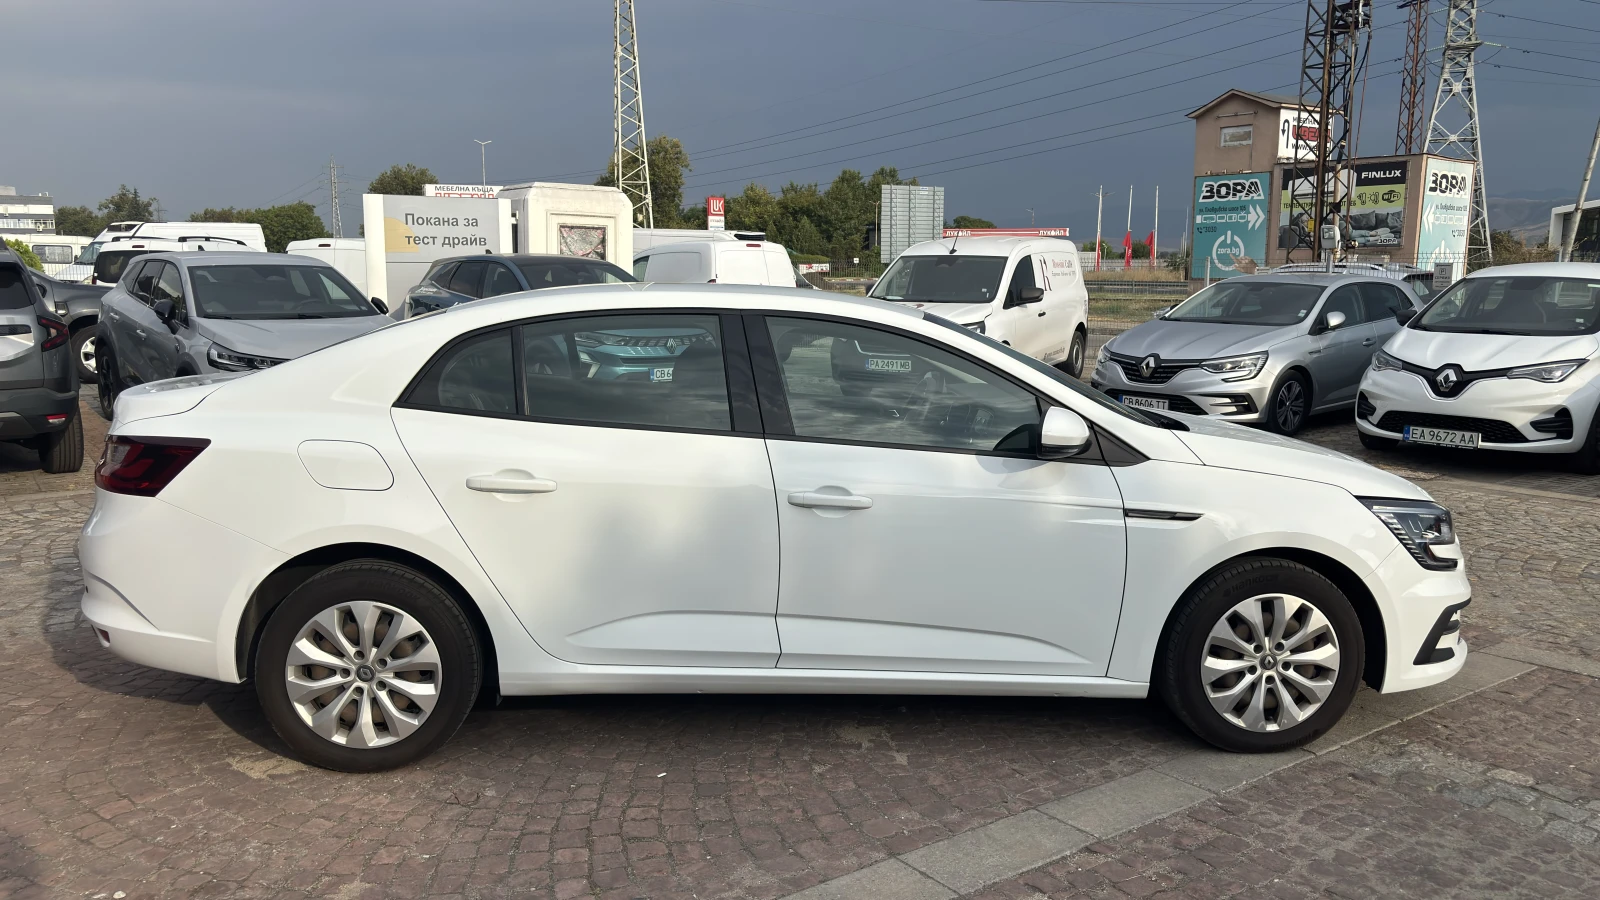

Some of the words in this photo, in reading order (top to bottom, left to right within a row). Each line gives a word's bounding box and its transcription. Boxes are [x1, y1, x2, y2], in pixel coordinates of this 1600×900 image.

[1361, 169, 1402, 179] FINLUX
[1200, 179, 1264, 202] ЗОРА
[1427, 170, 1468, 197] ЗОРА
[404, 212, 459, 227] Покана
[463, 217, 479, 227] за
[404, 235, 438, 246] тест
[441, 234, 487, 248] драйв
[1217, 246, 1240, 255] zora.bg
[1412, 428, 1426, 440] EA
[1428, 430, 1457, 443] 9672
[1459, 433, 1475, 445] AA
